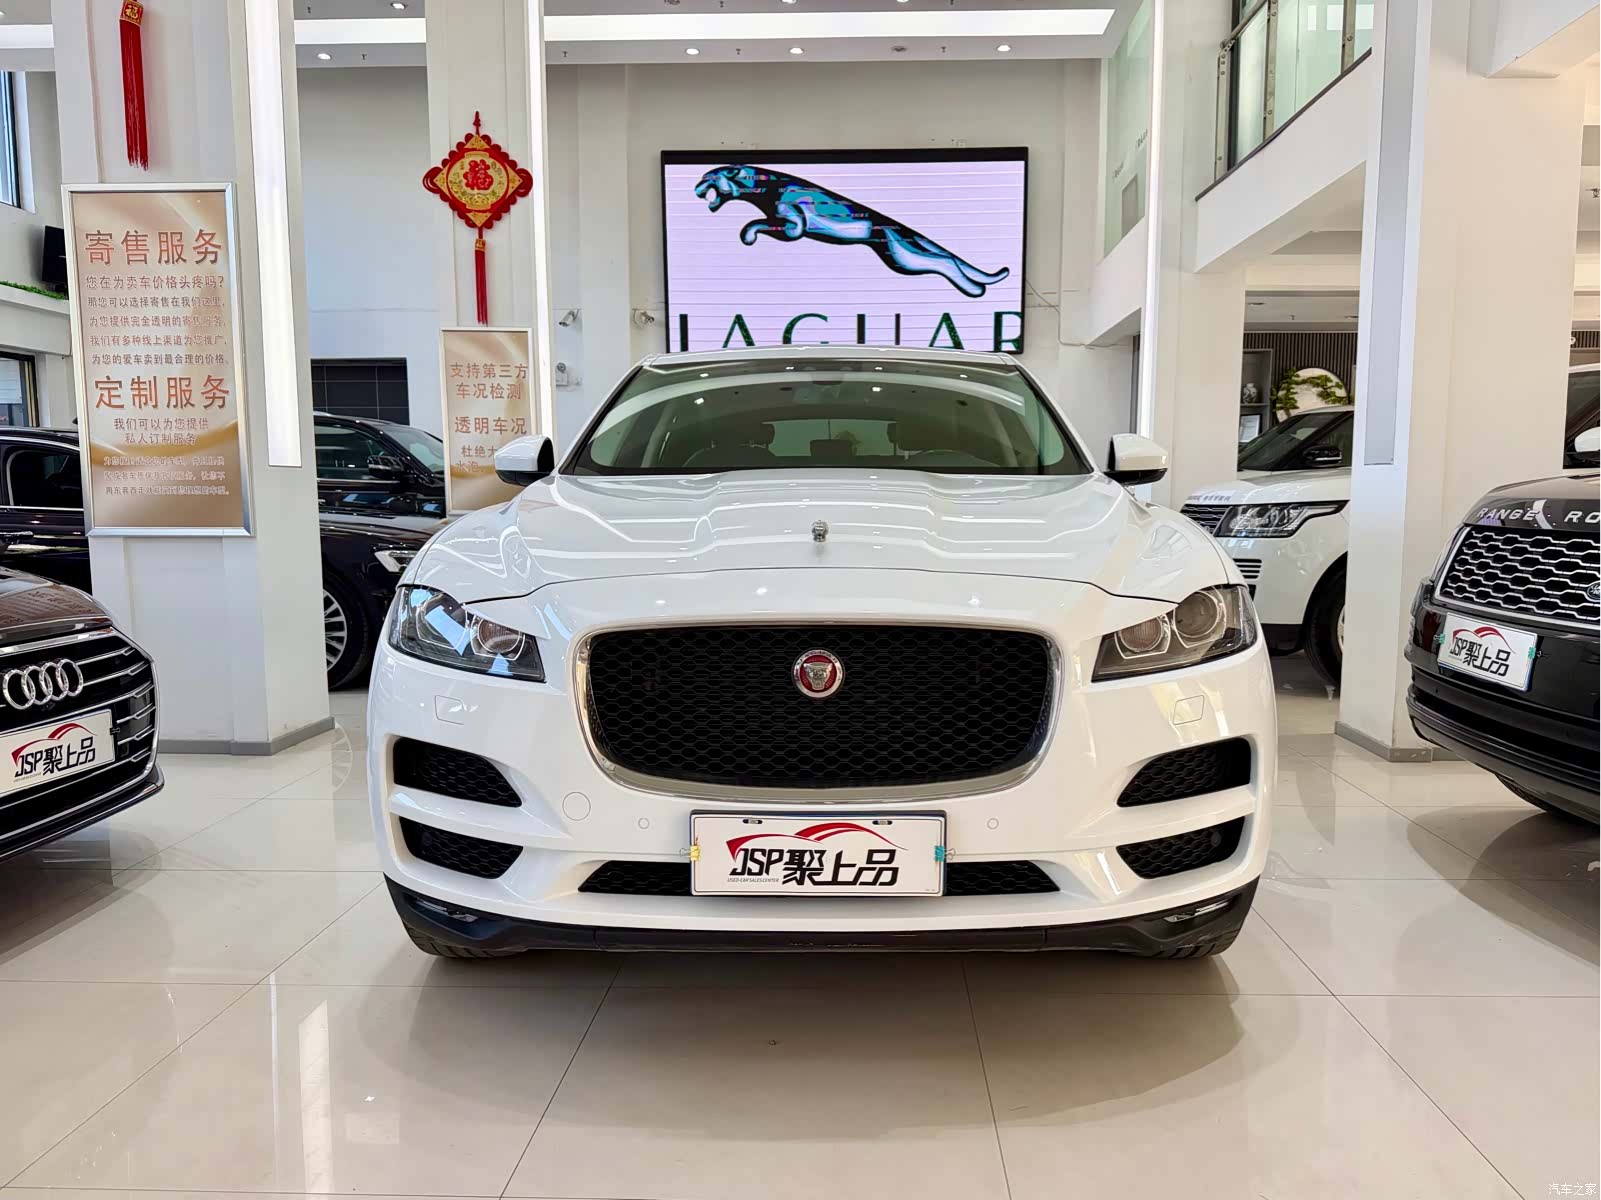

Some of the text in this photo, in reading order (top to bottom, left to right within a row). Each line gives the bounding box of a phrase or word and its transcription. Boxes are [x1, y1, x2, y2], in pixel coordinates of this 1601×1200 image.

[463, 159, 494, 190] 福
[85, 229, 222, 265] 寄售服务
[450, 363, 528, 379] 支持第三方
[94, 375, 229, 409] 定制服务
[456, 382, 521, 400] 车况检测
[114, 417, 209, 430] 我们可以为您提供
[454, 416, 528, 435] 透明车况
[125, 433, 196, 445] 私人订制服务
[1476, 507, 1541, 521] RANGE
